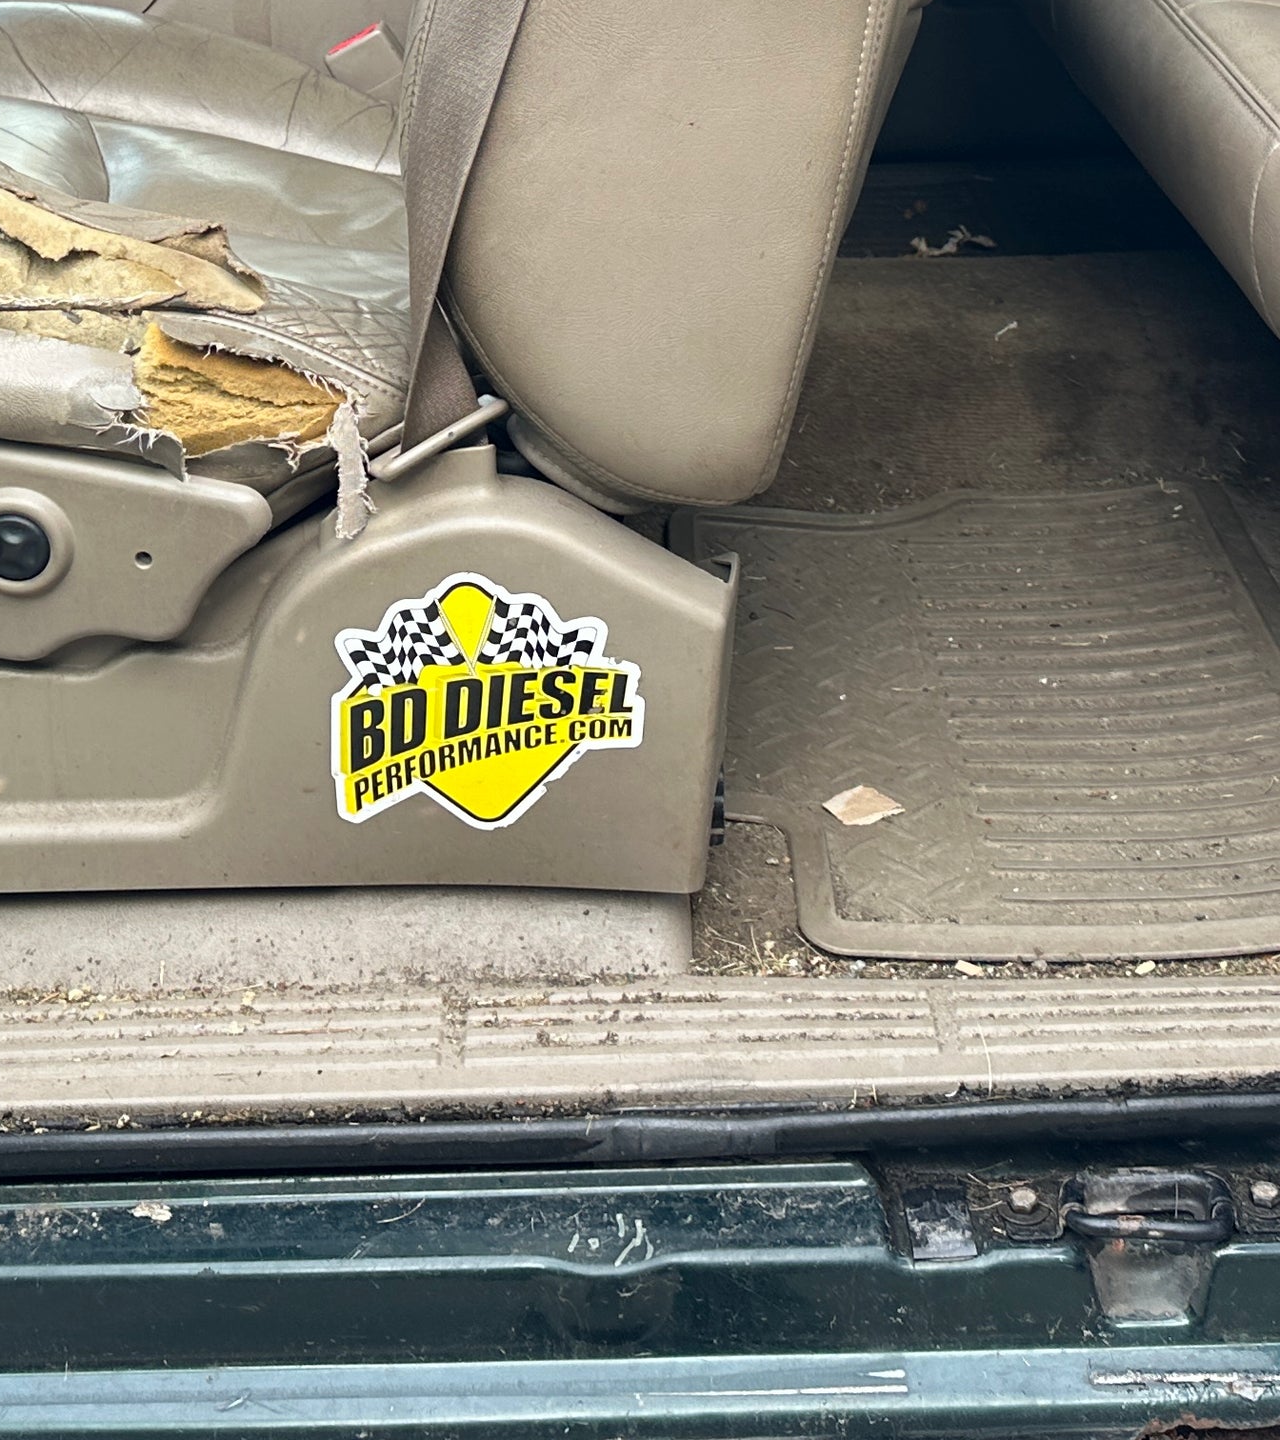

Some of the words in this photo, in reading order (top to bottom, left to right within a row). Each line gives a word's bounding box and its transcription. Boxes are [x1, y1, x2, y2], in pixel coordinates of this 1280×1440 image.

[349, 687, 427, 775] BD
[443, 670, 633, 740] DIESEL
[354, 718, 632, 813] PERFORMANCE.COM
